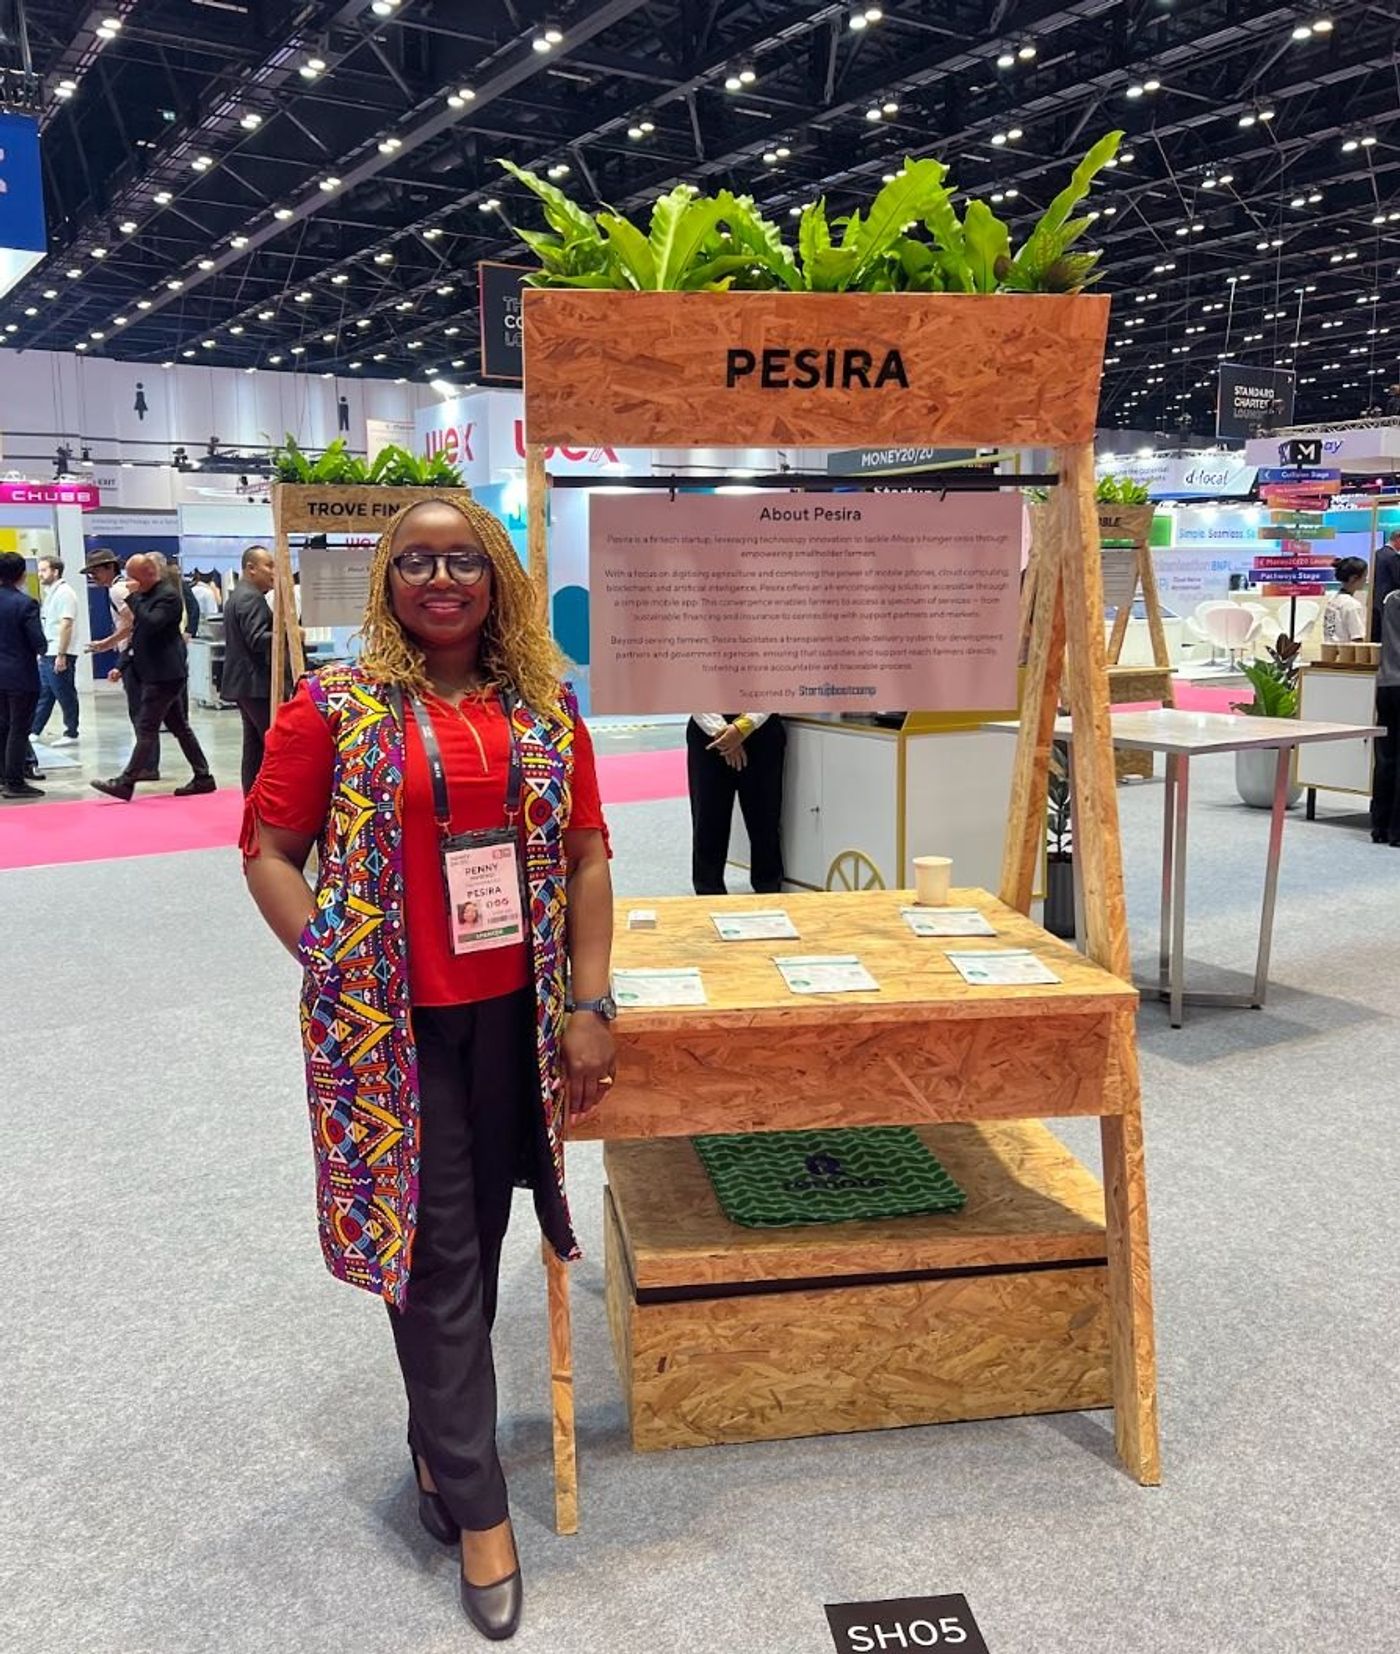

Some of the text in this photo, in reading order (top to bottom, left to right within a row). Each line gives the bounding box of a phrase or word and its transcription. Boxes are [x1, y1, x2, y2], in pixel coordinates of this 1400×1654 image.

[726, 348, 909, 389] PESIRA
[1234, 385, 1275, 399] STANDARD
[1234, 397, 1271, 409] CHARTE
[861, 448, 934, 467] MONEY20/20
[12, 490, 91, 502] CHUBB
[307, 502, 400, 517] TROVE FIN
[760, 507, 862, 522] About Pesira
[1098, 517, 1122, 527] BLE
[741, 550, 793, 560] empowering
[758, 569, 773, 578] and
[1260, 571, 1320, 582] Pathways Stage
[610, 635, 644, 646] Beyond
[739, 688, 783, 699] Supported
[465, 862, 498, 876] PENNY
[466, 886, 502, 899] PESIRA
